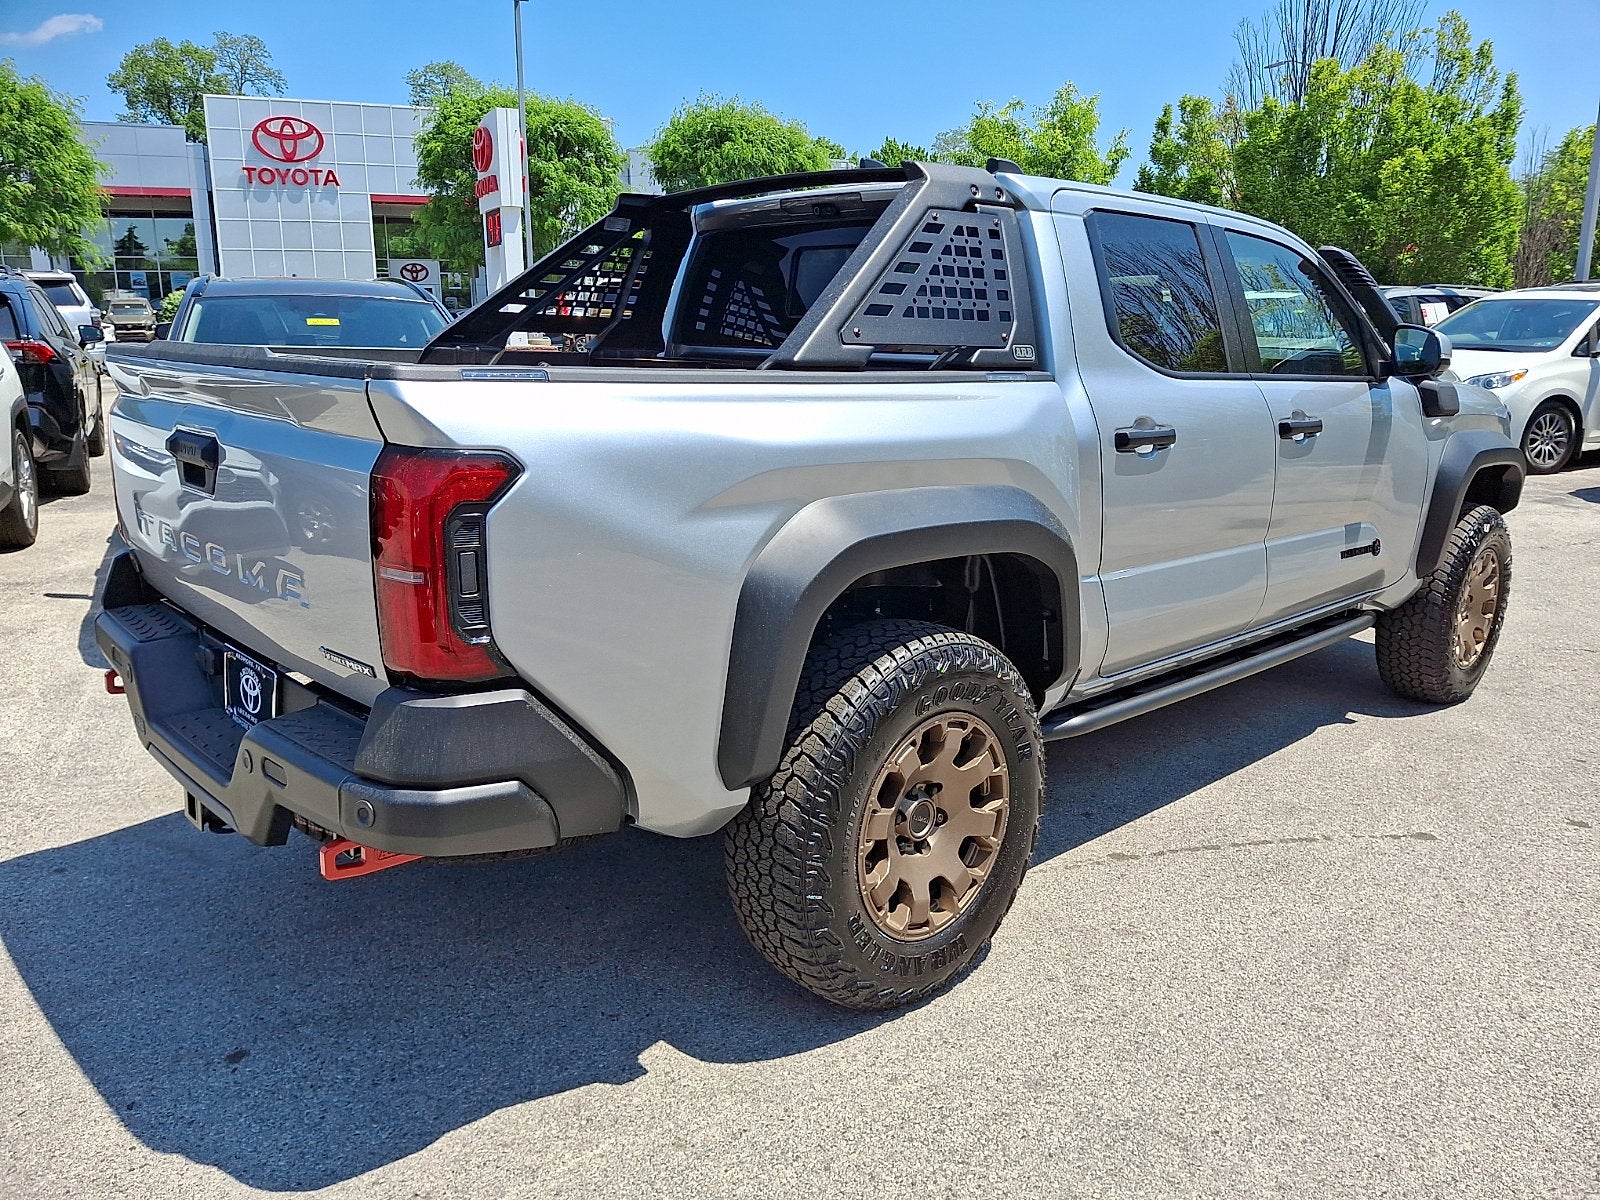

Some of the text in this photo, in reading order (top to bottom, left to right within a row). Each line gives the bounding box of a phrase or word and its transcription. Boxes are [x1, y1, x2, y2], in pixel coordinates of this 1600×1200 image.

[242, 167, 340, 186] TOYOTA
[137, 509, 311, 609] TACOMA
[848, 910, 968, 976] WRANGLER
